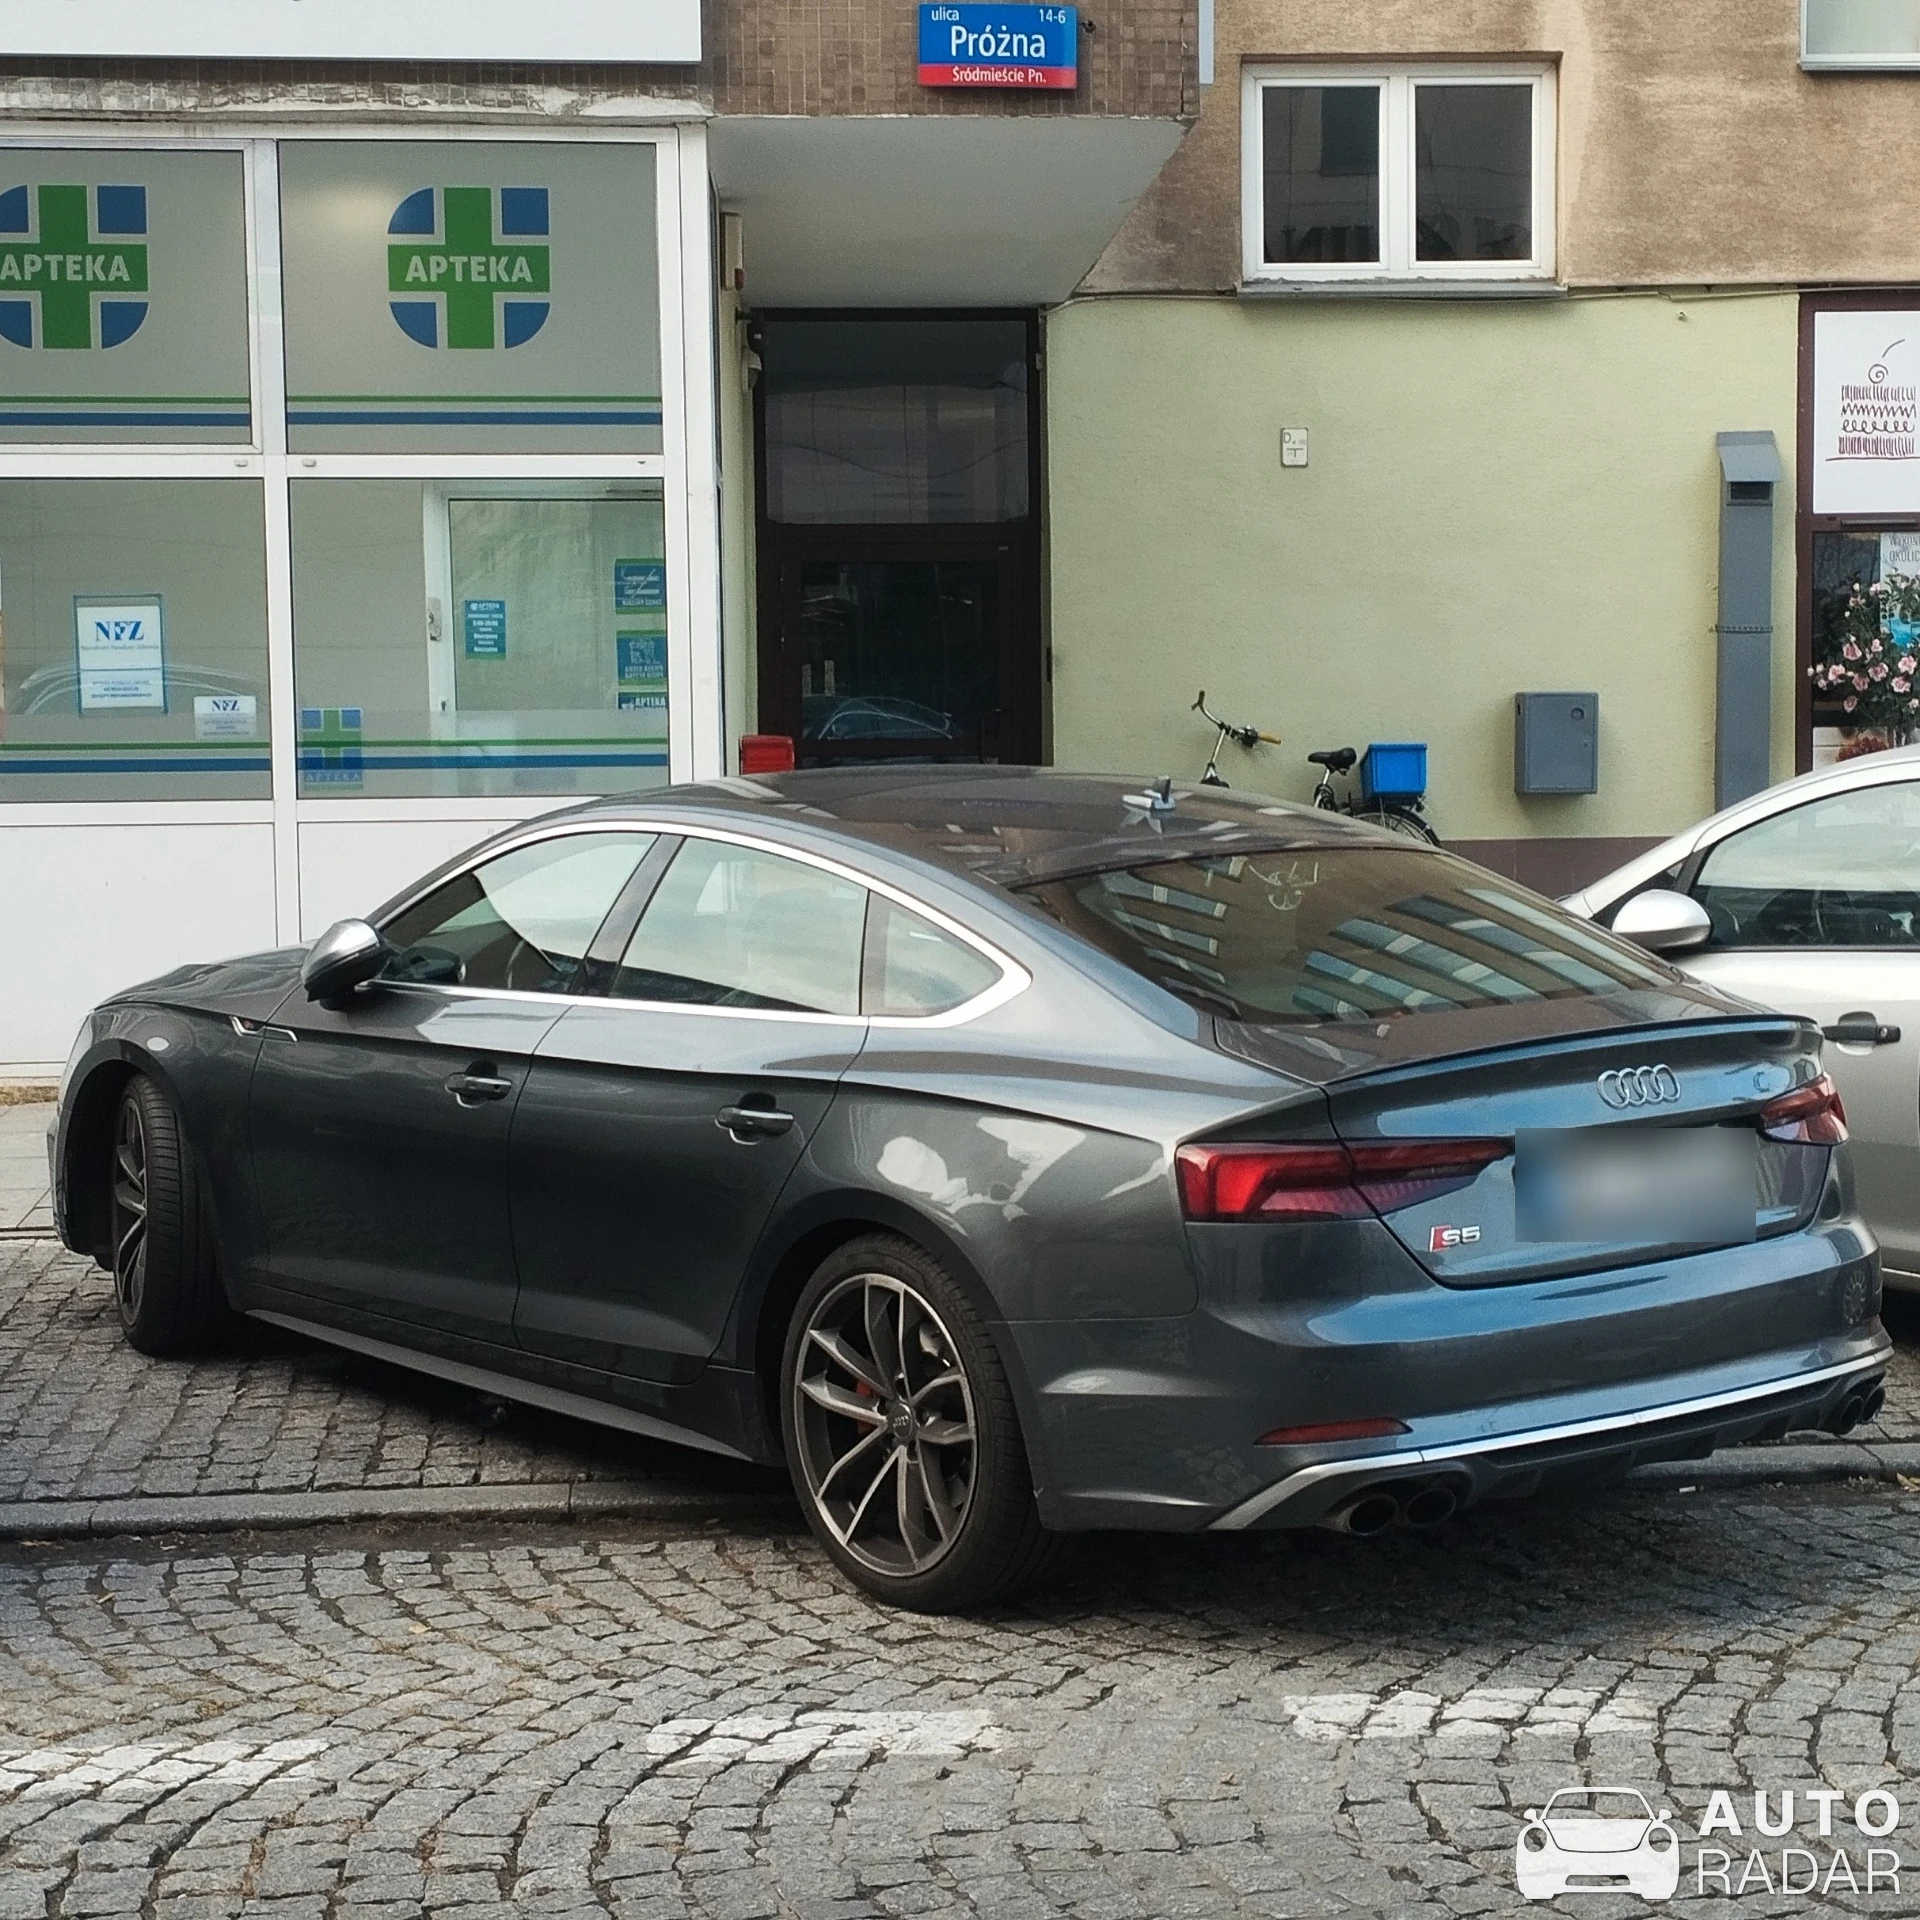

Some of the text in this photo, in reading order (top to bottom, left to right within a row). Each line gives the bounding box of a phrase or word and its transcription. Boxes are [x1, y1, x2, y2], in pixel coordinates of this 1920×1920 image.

[931, 6, 1066, 24] ulica 14-6
[950, 24, 1047, 58] Próżna
[952, 65, 1047, 83] Śródmieście Pn.
[0, 254, 130, 281] APTEKA
[405, 254, 533, 282] APTEKA
[95, 621, 144, 641] NFZ
[212, 700, 240, 712] NFZ
[1443, 1226, 1481, 1245] S5
